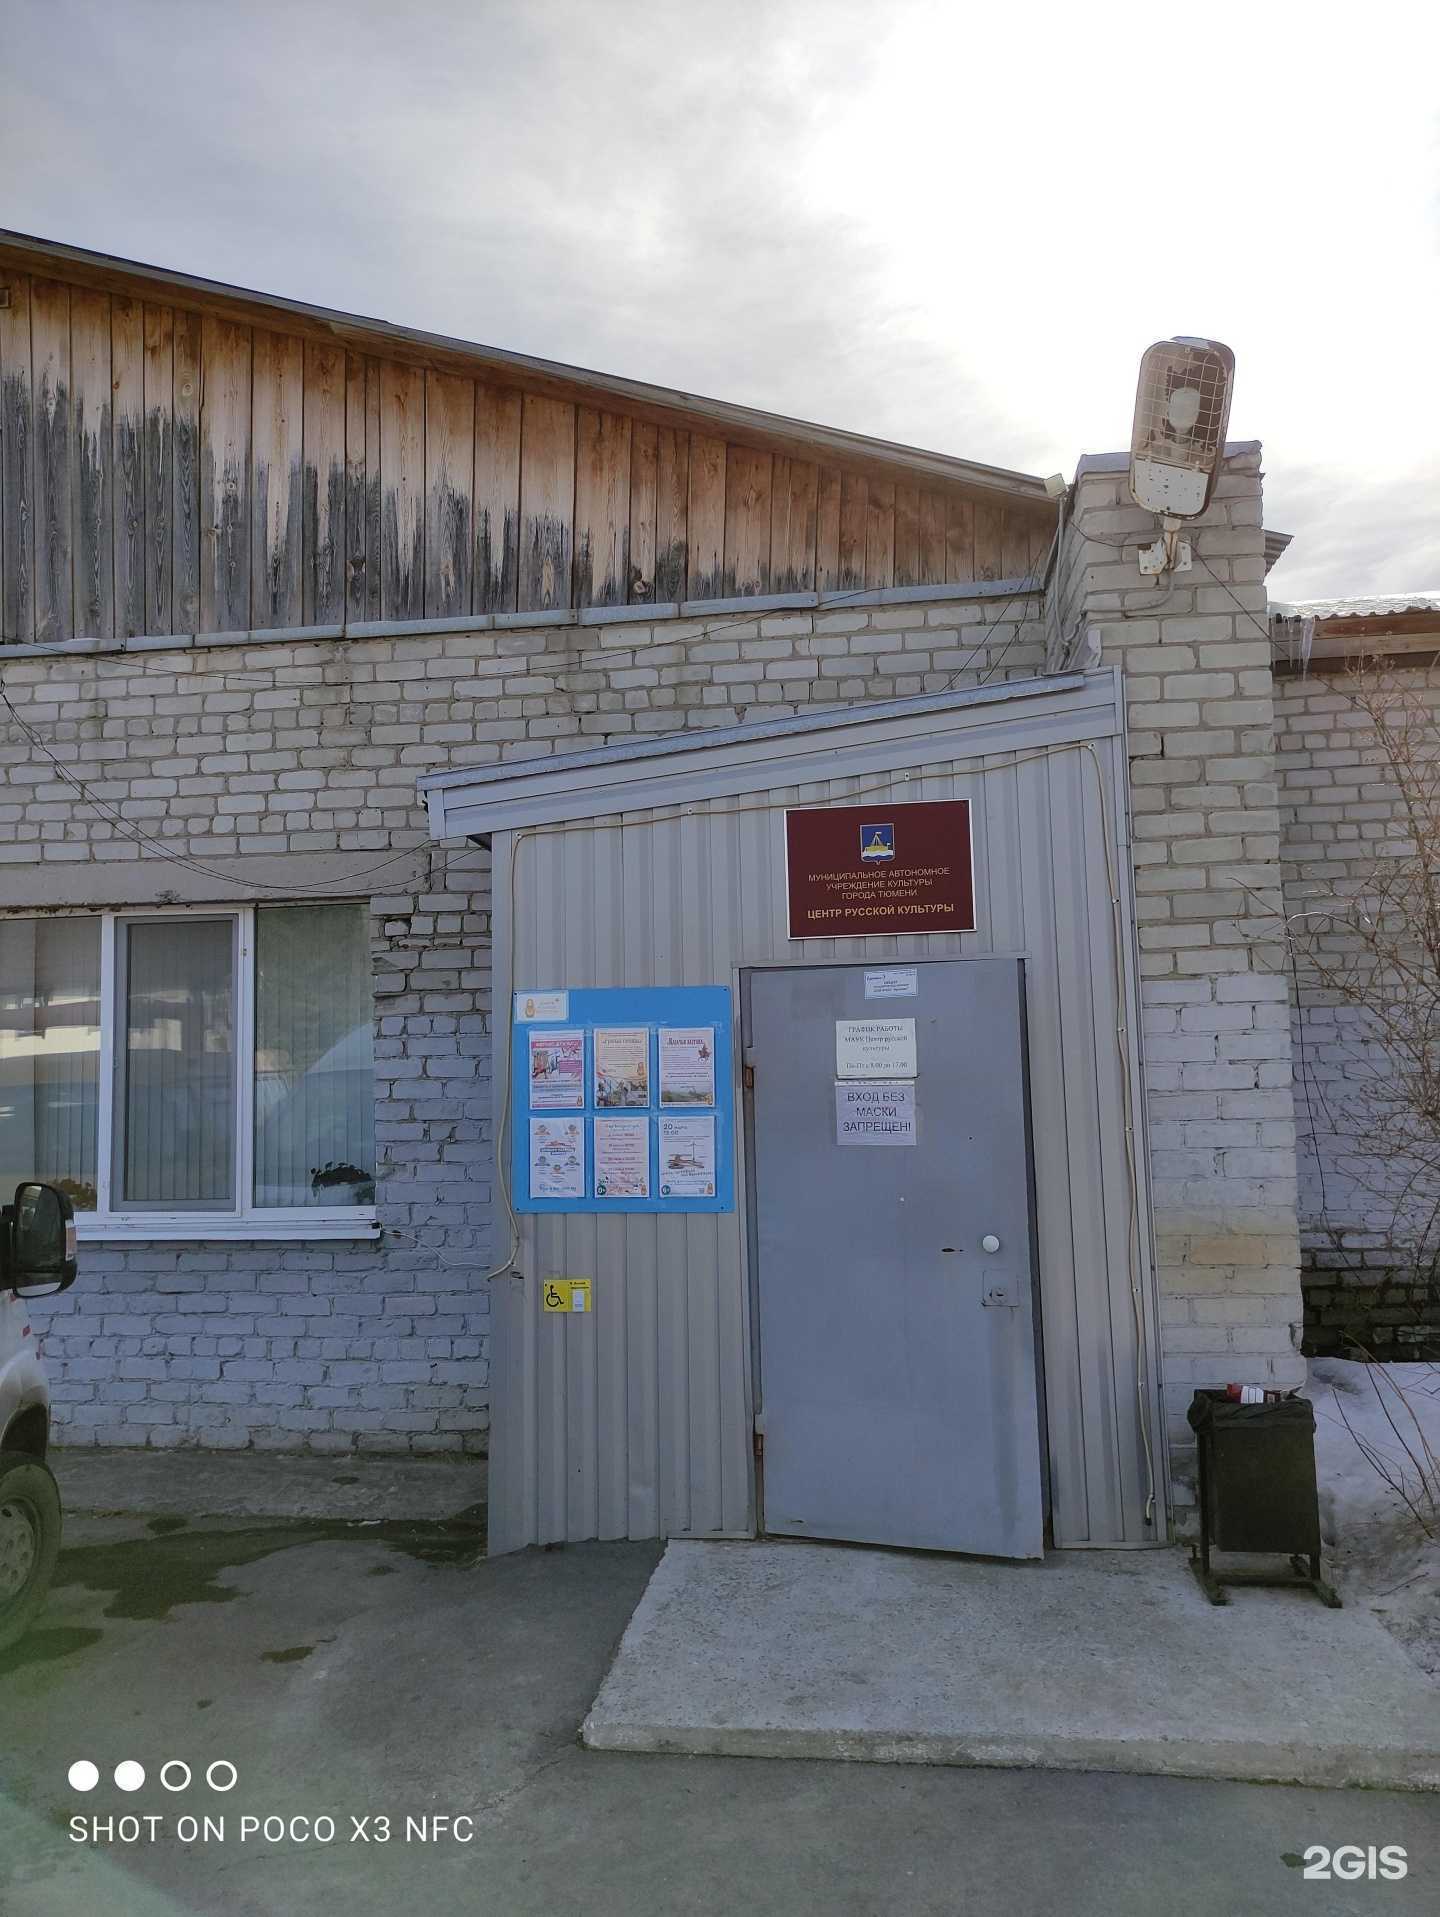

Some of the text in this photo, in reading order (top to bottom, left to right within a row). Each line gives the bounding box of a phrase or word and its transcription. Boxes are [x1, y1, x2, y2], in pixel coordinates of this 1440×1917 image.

[808, 867, 950, 882] МУНИЦИПАЛЬНОЕ АВТОНОМНОЕ
[826, 879, 933, 891] УЧРЕЖДЕНИЕ КУЛЬТУРЫ
[841, 889, 918, 900] ГОРОДА ТЮМЕНИ
[807, 903, 954, 920] ЦЕНТР РУССКОЙ КУЛЬТУРЫ
[847, 1091, 905, 1104] ВХОД БЕЗ
[856, 1106, 897, 1117] МАСКИ
